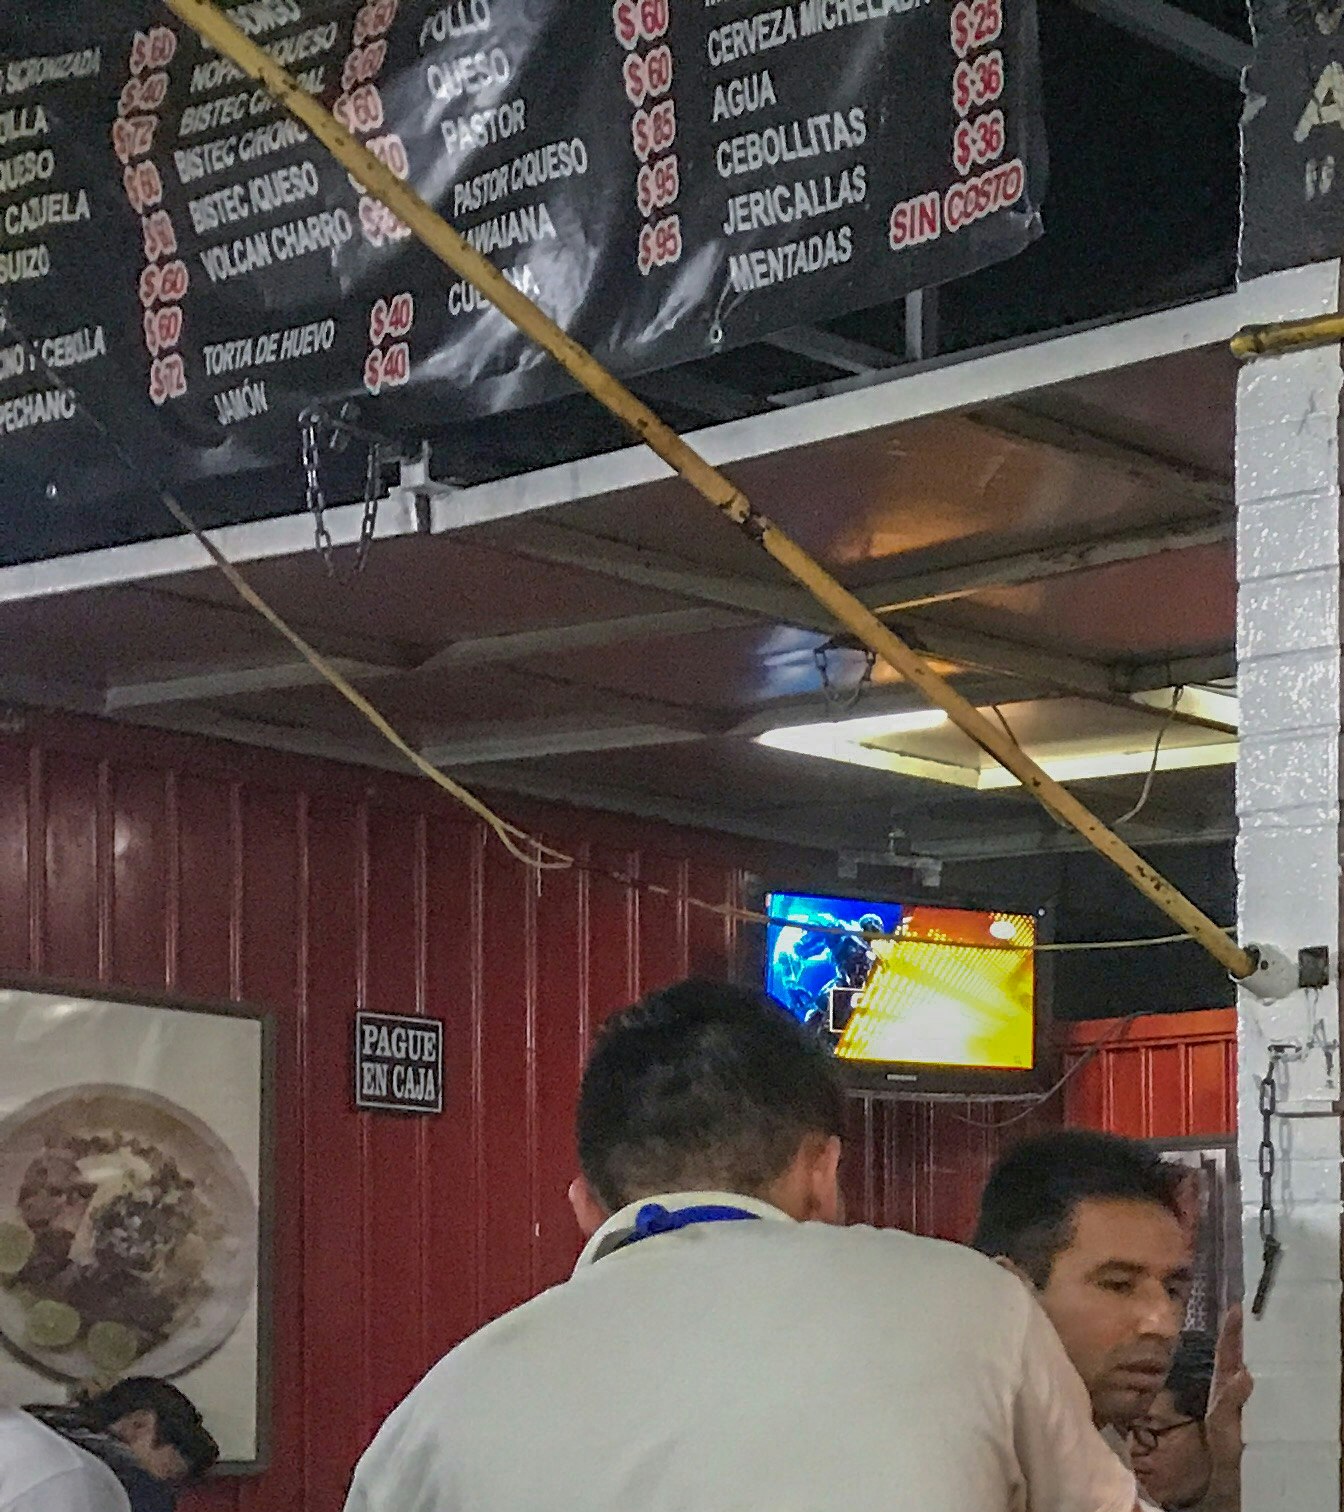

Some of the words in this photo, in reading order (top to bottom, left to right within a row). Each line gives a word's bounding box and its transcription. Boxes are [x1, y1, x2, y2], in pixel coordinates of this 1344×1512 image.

[708, 6, 797, 67] CERVEZA
[427, 48, 510, 101] QUESO
[712, 70, 776, 122] AGUA
[441, 98, 526, 152] PASTOR
[716, 107, 867, 178] CEBOLLITAS
[453, 170, 510, 216] PASTOR
[723, 165, 867, 236] JERICALLAS
[891, 192, 941, 250] SIN
[944, 158, 1024, 232] COSTO
[200, 231, 273, 282] VOLCAN
[271, 207, 352, 261] CHARRO
[729, 226, 852, 293] MENTADAS
[203, 336, 253, 376] TORTA
[255, 333, 281, 365] DE
[280, 318, 335, 358] HUEVO
[362, 1024, 436, 1062] PAGUE
[361, 1062, 388, 1096] EN
[392, 1064, 436, 1101] CAJA
